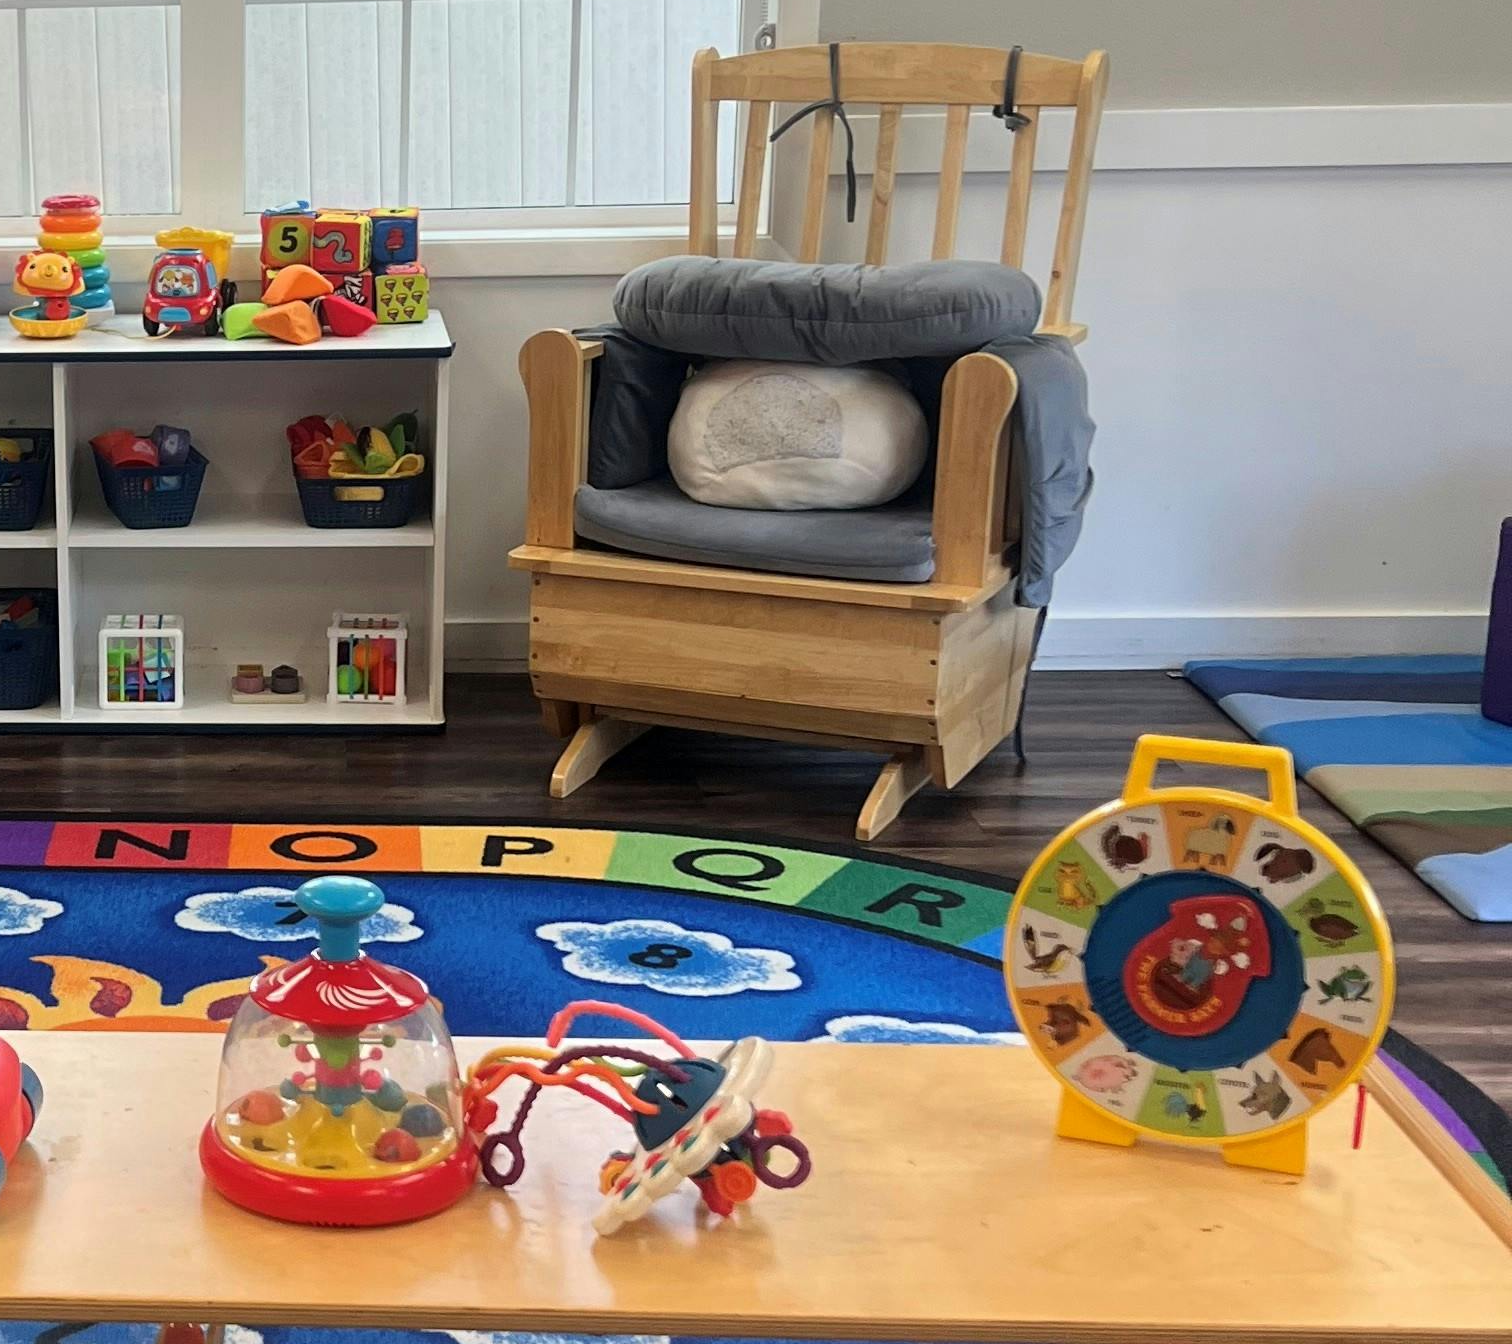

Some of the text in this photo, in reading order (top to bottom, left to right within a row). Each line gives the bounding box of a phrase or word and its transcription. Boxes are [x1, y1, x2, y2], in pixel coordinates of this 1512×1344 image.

[279, 226, 299, 254] 5
[94, 829, 190, 861] N
[269, 831, 379, 863] O
[481, 834, 555, 868] P
[673, 848, 786, 892] Q
[864, 882, 966, 928] R
[628, 943, 693, 970] 8
